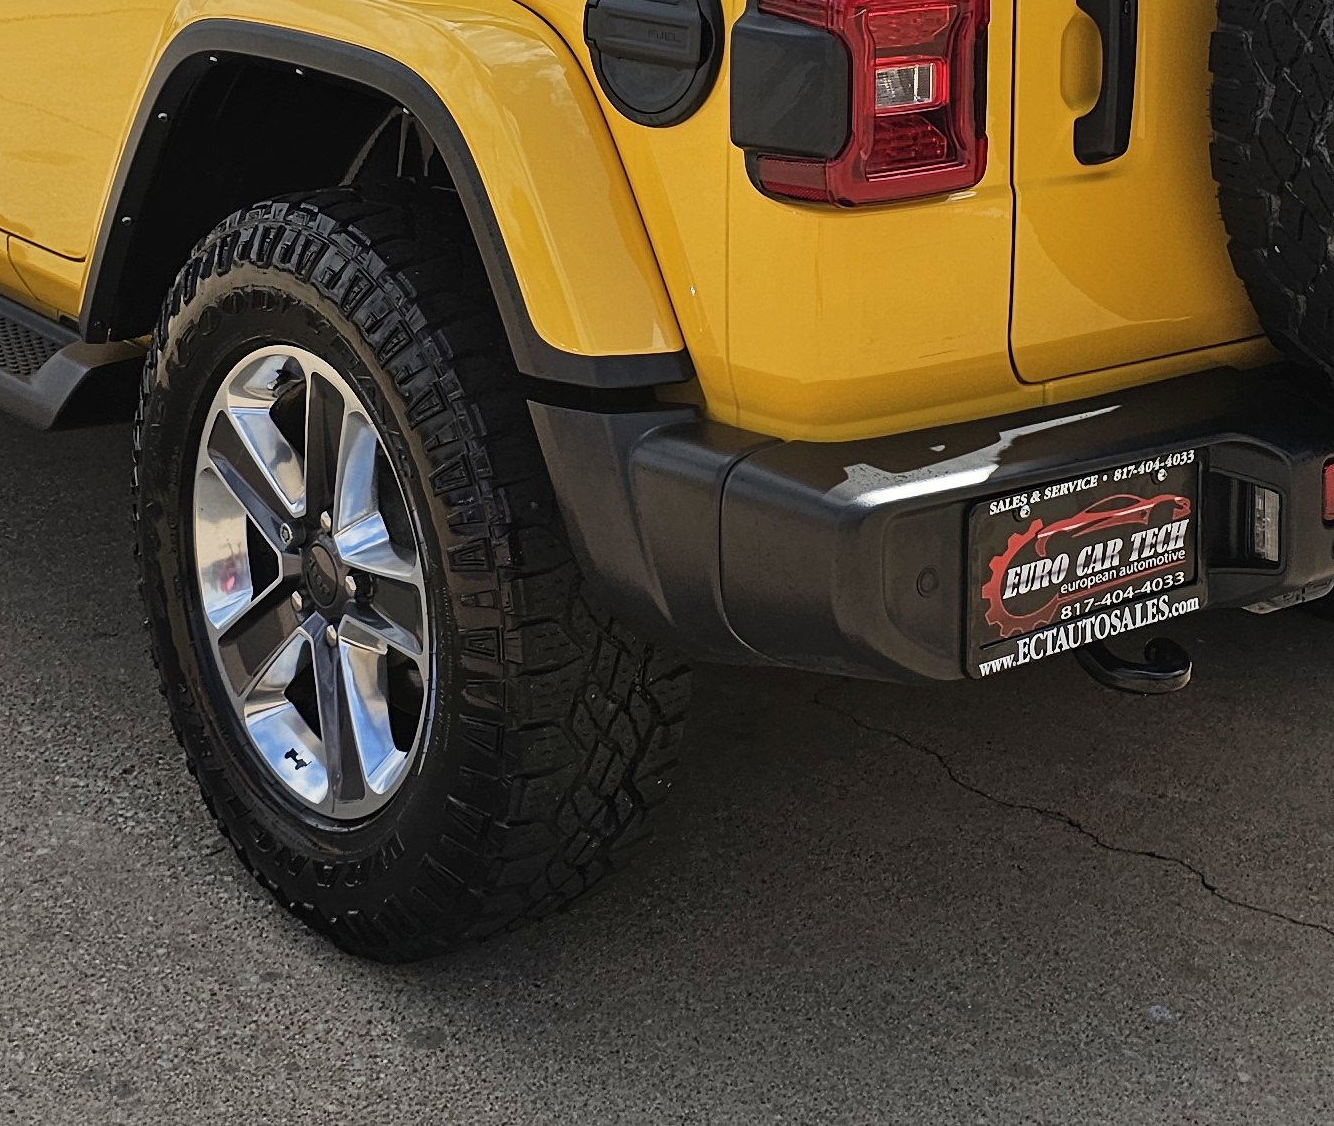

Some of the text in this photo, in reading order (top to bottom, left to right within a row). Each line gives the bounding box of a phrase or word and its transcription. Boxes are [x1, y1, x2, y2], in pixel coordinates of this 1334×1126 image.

[989, 449, 1195, 516] SALES & SERVICE 817-404-4033
[1002, 518, 1190, 600] EURO CAR TECH
[1060, 548, 1186, 595] european automotive
[1060, 571, 1185, 620] 817-404-4033
[978, 595, 1200, 677] www.ECTAUTOSALES.com
